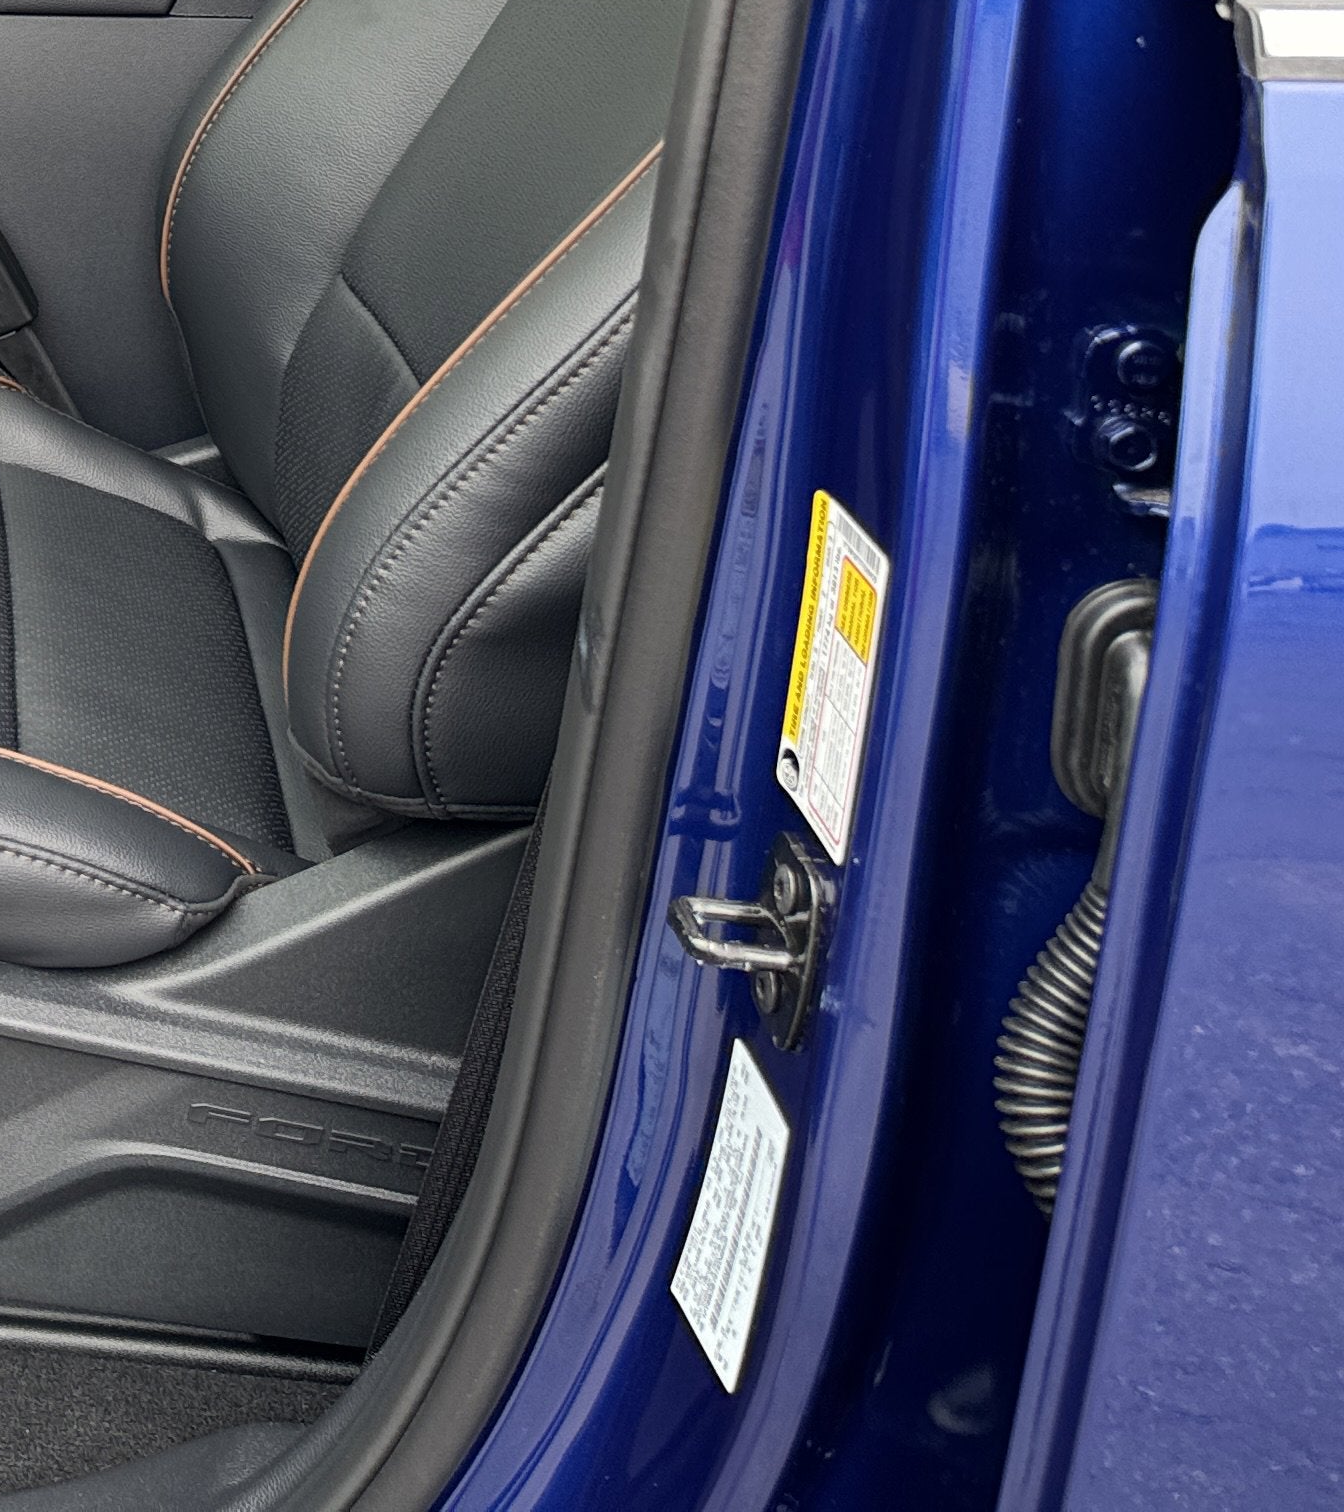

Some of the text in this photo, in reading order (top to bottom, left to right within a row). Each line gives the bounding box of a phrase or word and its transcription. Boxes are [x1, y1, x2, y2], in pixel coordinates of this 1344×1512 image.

[808, 497, 829, 601] INFORMATION
[799, 599, 815, 669] LOADING
[794, 667, 805, 701] AND
[789, 702, 800, 738] TIRE
